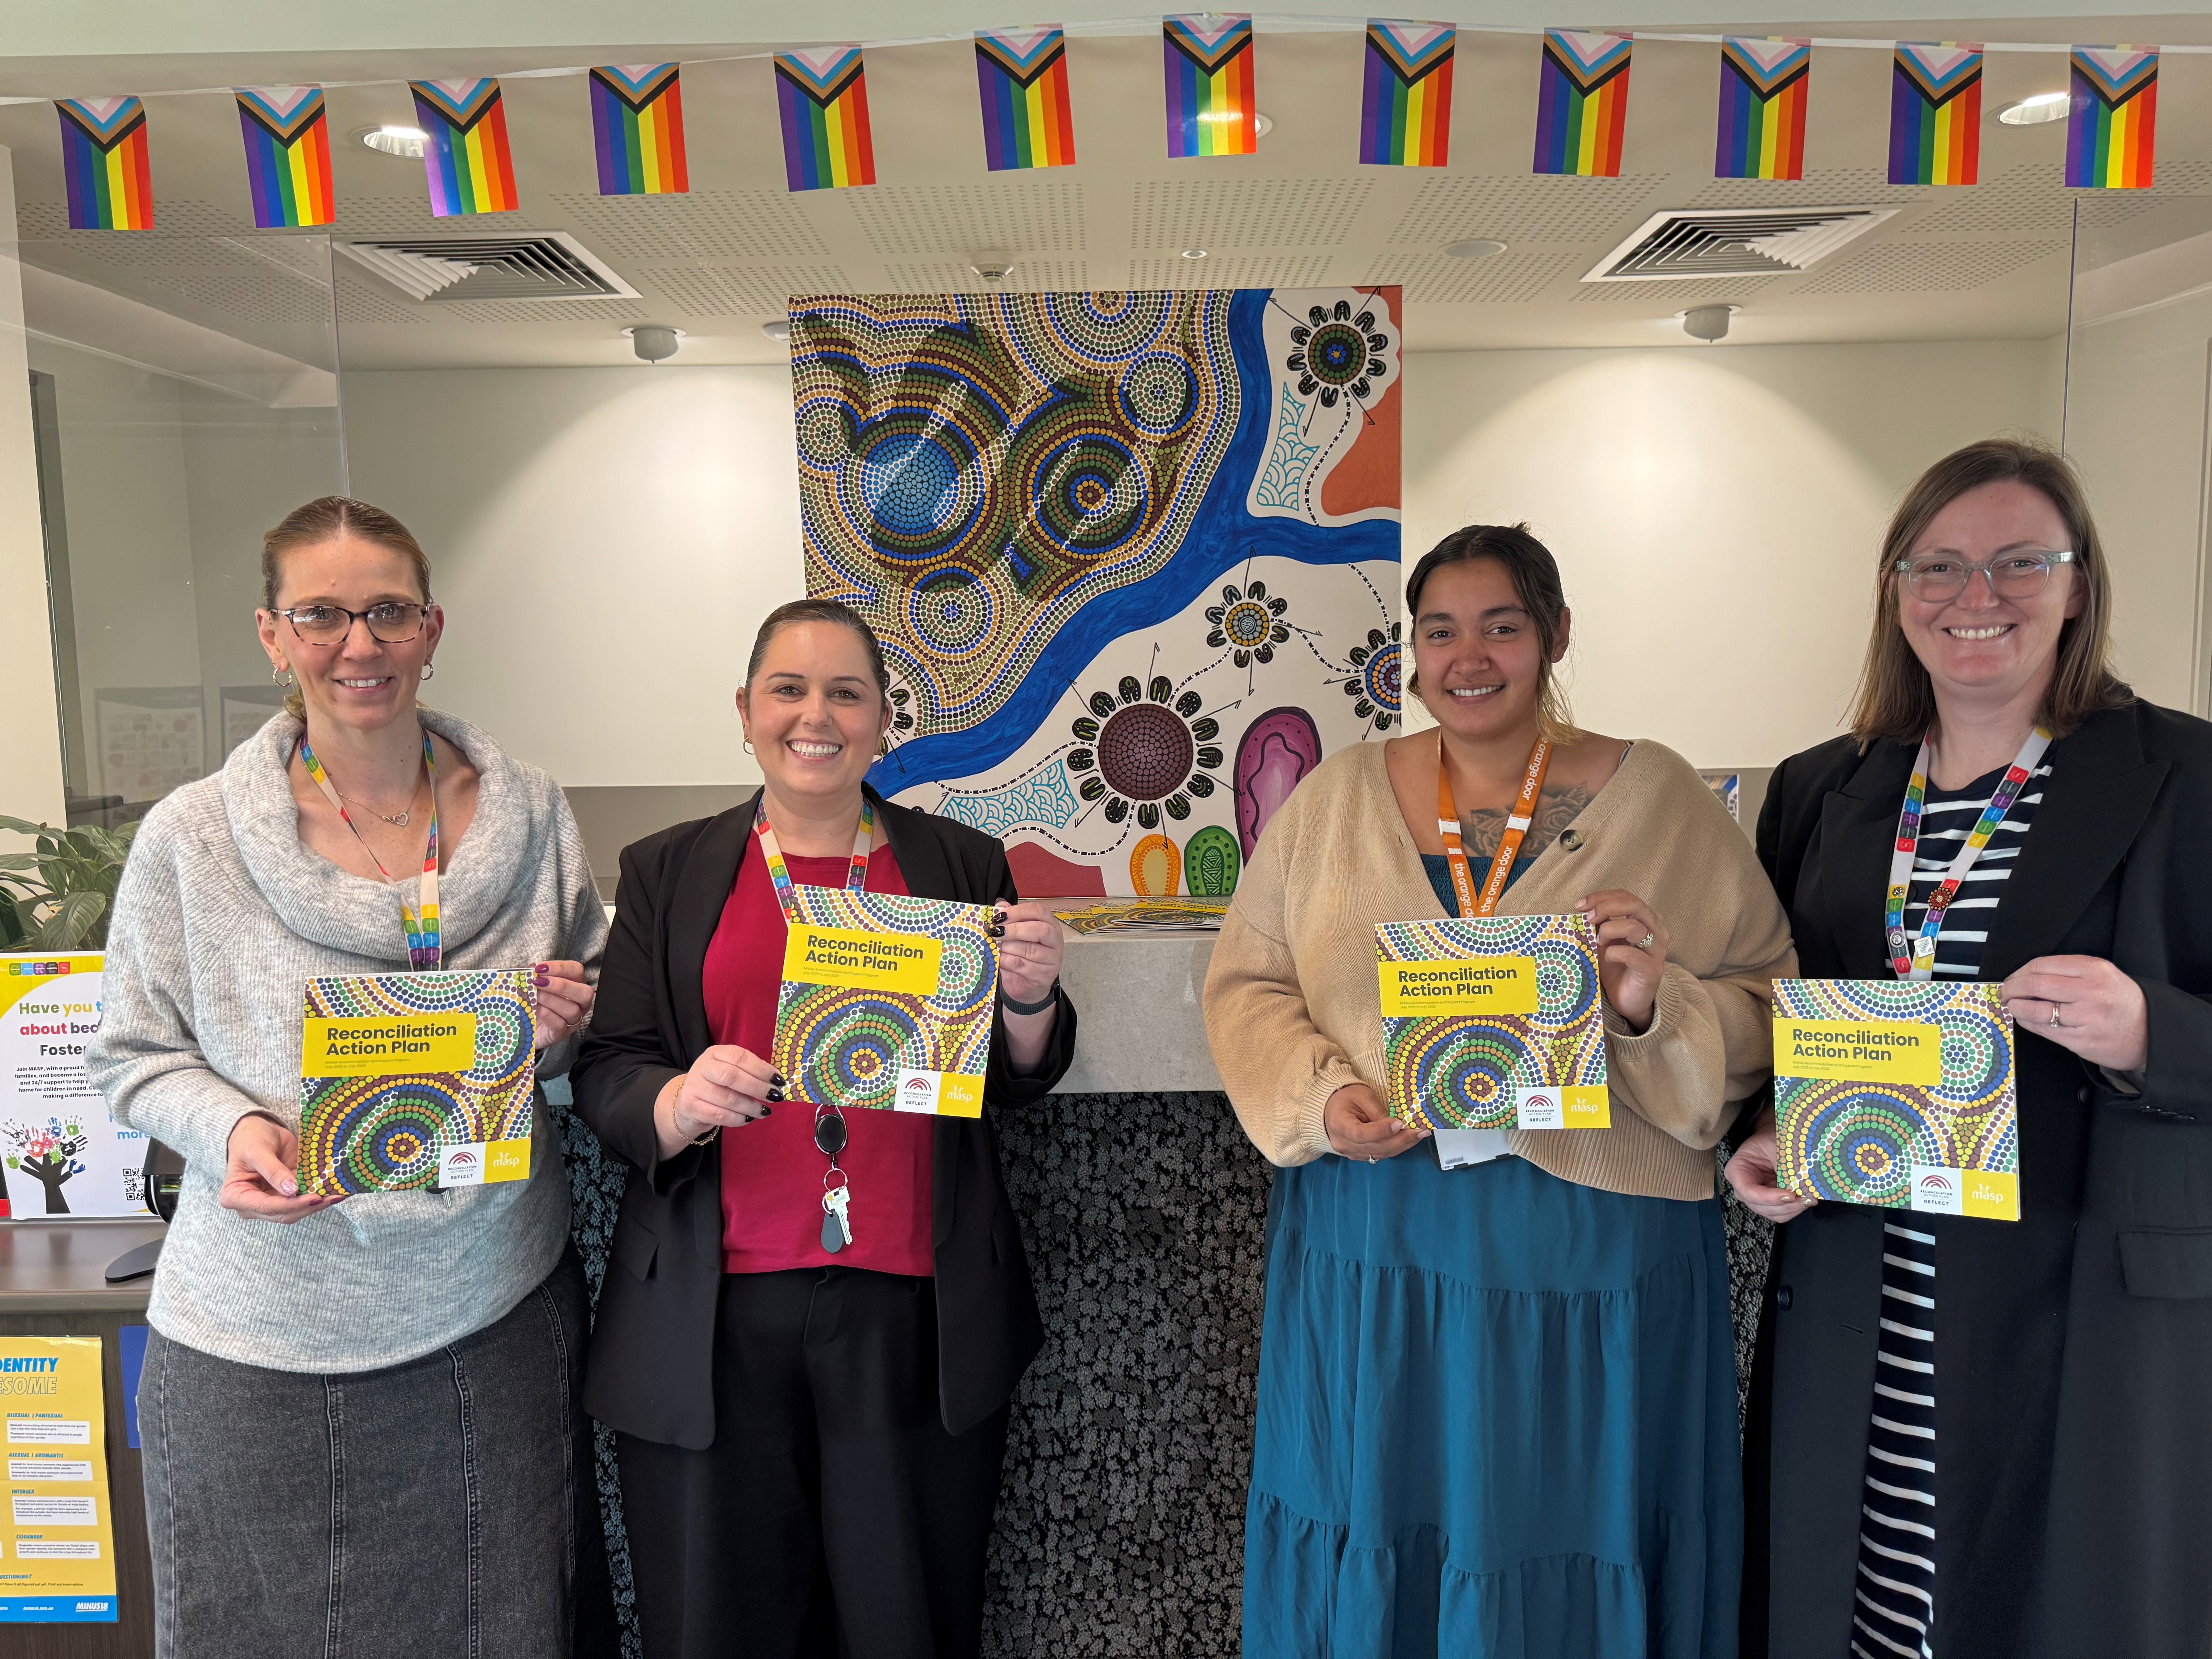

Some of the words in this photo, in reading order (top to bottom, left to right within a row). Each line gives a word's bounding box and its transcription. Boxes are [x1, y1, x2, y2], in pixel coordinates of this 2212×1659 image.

[1529, 744, 1546, 778] orange
[1522, 778, 1537, 801] door
[1454, 863, 1465, 877] the
[1480, 896, 1494, 913] the
[1488, 866, 1506, 896] orange
[1498, 846, 1513, 866] door
[1458, 878, 1472, 907] orange
[808, 935, 924, 959] Reconciliation
[805, 950, 858, 967] Action
[863, 956, 898, 971] Plan
[1398, 966, 1517, 982] Reconciliation
[1400, 983, 1452, 996] Action
[1457, 983, 1493, 995] Plan
[19, 1003, 59, 1014] Have
[62, 1003, 92, 1017] you
[20, 1023, 67, 1035] about
[328, 1023, 457, 1040] Reconciliation
[1793, 1029, 1919, 1046] Reconciliation
[326, 1041, 386, 1055] Action
[392, 1041, 430, 1053] Plan
[1793, 1044, 1848, 1058] Action
[1853, 1046, 1892, 1061] Plan
[947, 1091, 972, 1103] masp
[1571, 1104, 1598, 1114] masp
[493, 1156, 519, 1167] masp
[1972, 1190, 2003, 1204] masp
